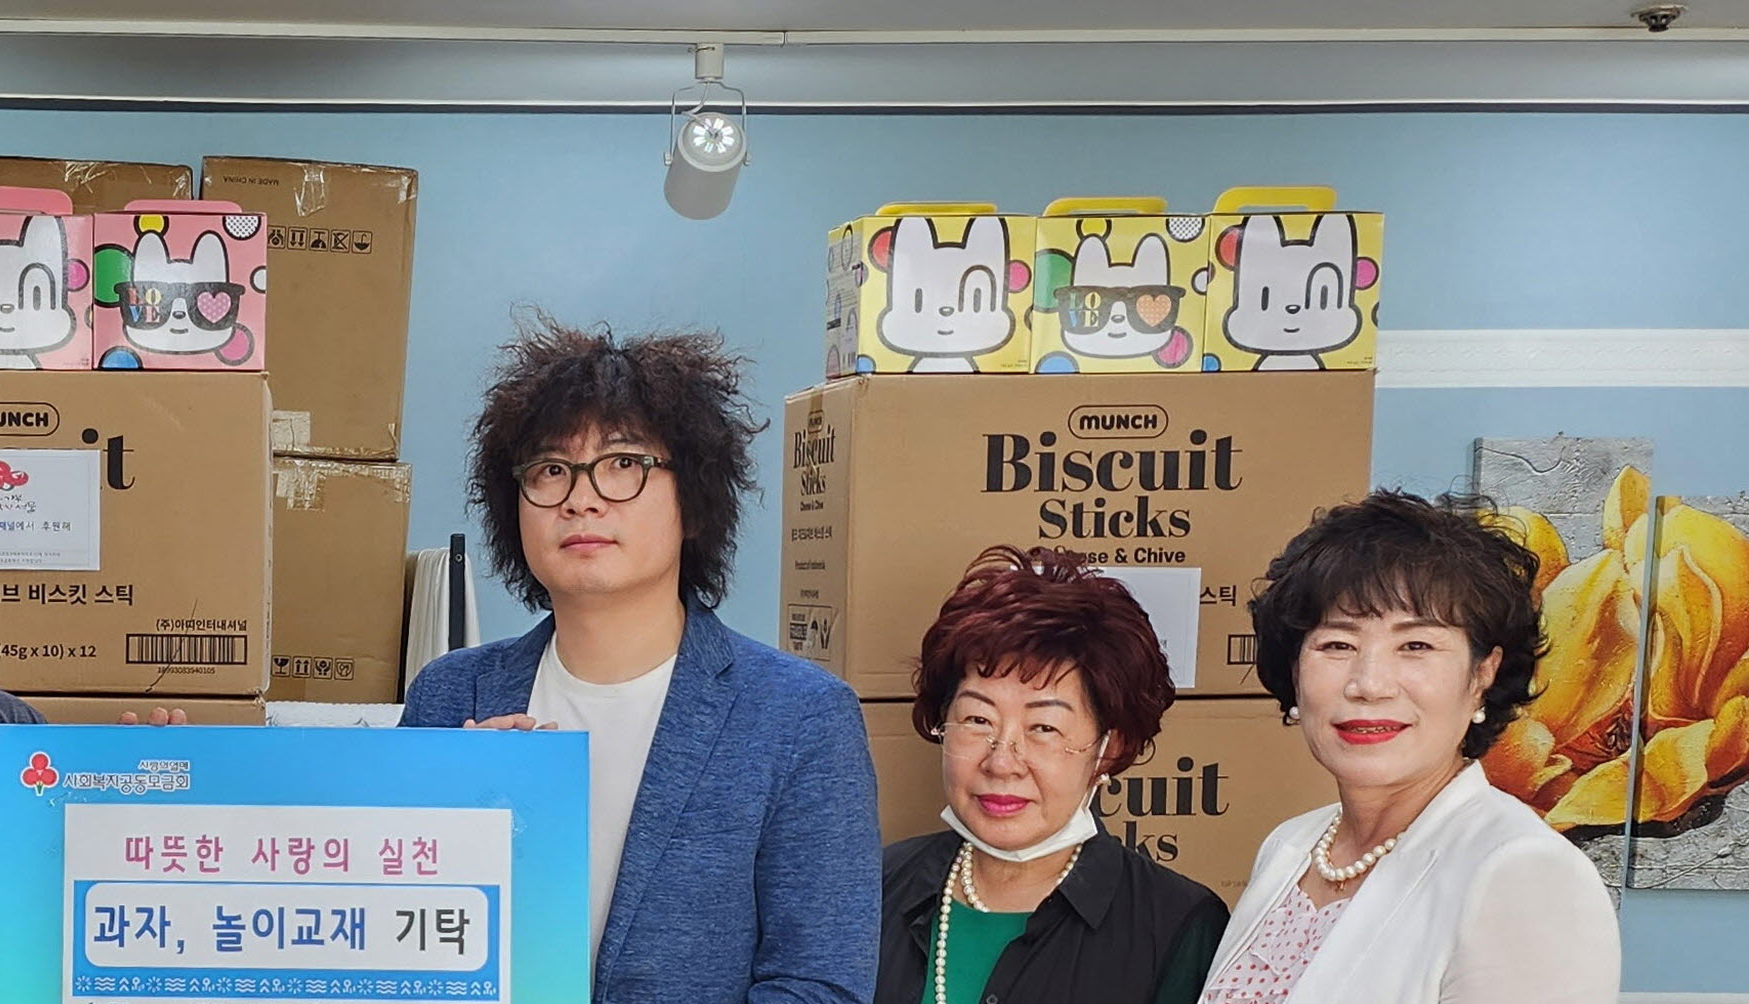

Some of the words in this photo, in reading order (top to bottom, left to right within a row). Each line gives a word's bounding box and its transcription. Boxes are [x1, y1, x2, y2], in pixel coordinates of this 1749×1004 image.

[1079, 414, 1158, 430] MUNCH
[980, 429, 1244, 493] Biscuit
[1038, 495, 1191, 540] Sticks
[1114, 549, 1128, 564] &
[1134, 547, 1186, 564] Chive
[27, 582, 88, 606] 비스킷
[94, 584, 134, 607] 스틱
[30, 647, 40, 657] x
[42, 643, 65, 661] 10)
[67, 647, 77, 657] x
[80, 645, 97, 658] 12
[63, 773, 190, 794] 사회복지공동모금회
[1098, 756, 1230, 817] cuit
[125, 834, 225, 875] 따뜻한
[251, 837, 350, 876] 사랑의
[378, 836, 440, 877] 실천
[93, 904, 185, 954] 과자,
[212, 904, 366, 952] 놀이교재
[395, 908, 471, 955] 기탁
